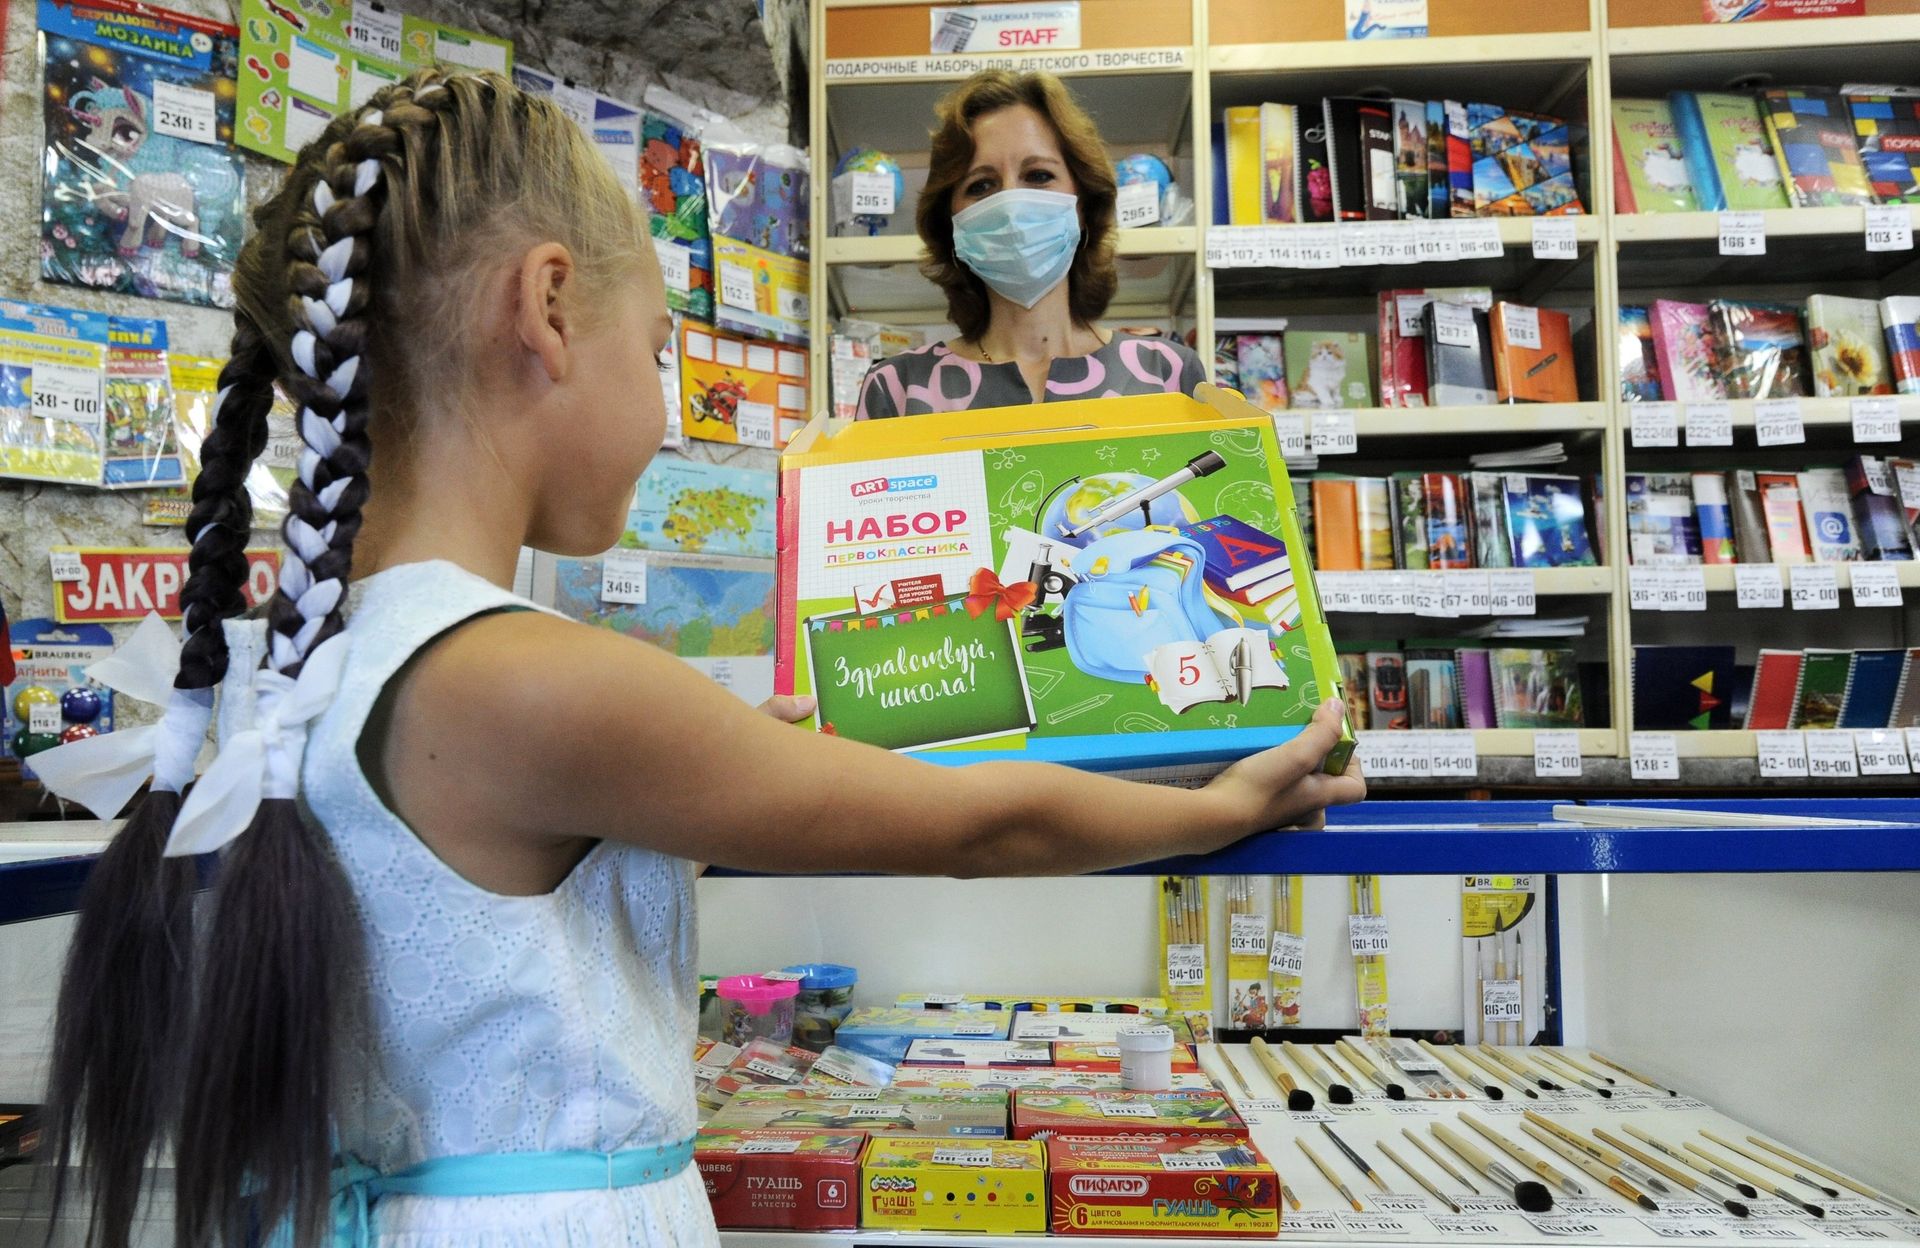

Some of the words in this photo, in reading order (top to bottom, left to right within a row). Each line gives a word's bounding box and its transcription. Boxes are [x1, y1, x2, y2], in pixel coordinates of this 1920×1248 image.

[96, 23, 193, 58] МОЗАИКА
[1000, 28, 1058, 46] STAFF
[826, 61, 918, 76] ПОДАРОЧНЫЕ
[925, 58, 982, 73] НАБОРЫ
[1018, 55, 1089, 71] ДЕТСКОГО
[1096, 51, 1184, 67] ТВОРЧЕСТВА
[0, 336, 62, 353] АСТОЛЬНАЯ
[34, 391, 97, 413] 38-00
[858, 497, 883, 506] уроки
[886, 493, 931, 504] творчества
[826, 509, 967, 544] НАБОР
[827, 542, 969, 564] ПЕРВОКЛАССНИКА
[67, 560, 275, 611] ЗАКРО
[35, 651, 92, 660] BRAUBERG
[16, 666, 68, 678] АГНИТЫ
[834, 636, 995, 698] Здравствуй,
[1178, 654, 1200, 685] 5
[881, 663, 976, 709] школа!
[1478, 877, 1530, 886] BRERG
[1231, 937, 1266, 949] 93-00
[1271, 956, 1302, 971] 44-00
[1169, 967, 1204, 980] 94-00
[697, 1164, 733, 1172] AUBERG
[747, 1176, 803, 1190] ГУАШЬ
[828, 1184, 838, 1198] 6
[1075, 1178, 1143, 1193] ПИФАГОР
[872, 1195, 915, 1213] Гуашь
[1152, 1198, 1220, 1217] ГУАШЬ
[1076, 1206, 1088, 1225] 6
[1091, 1210, 1122, 1218] ЦВЕТОВ
